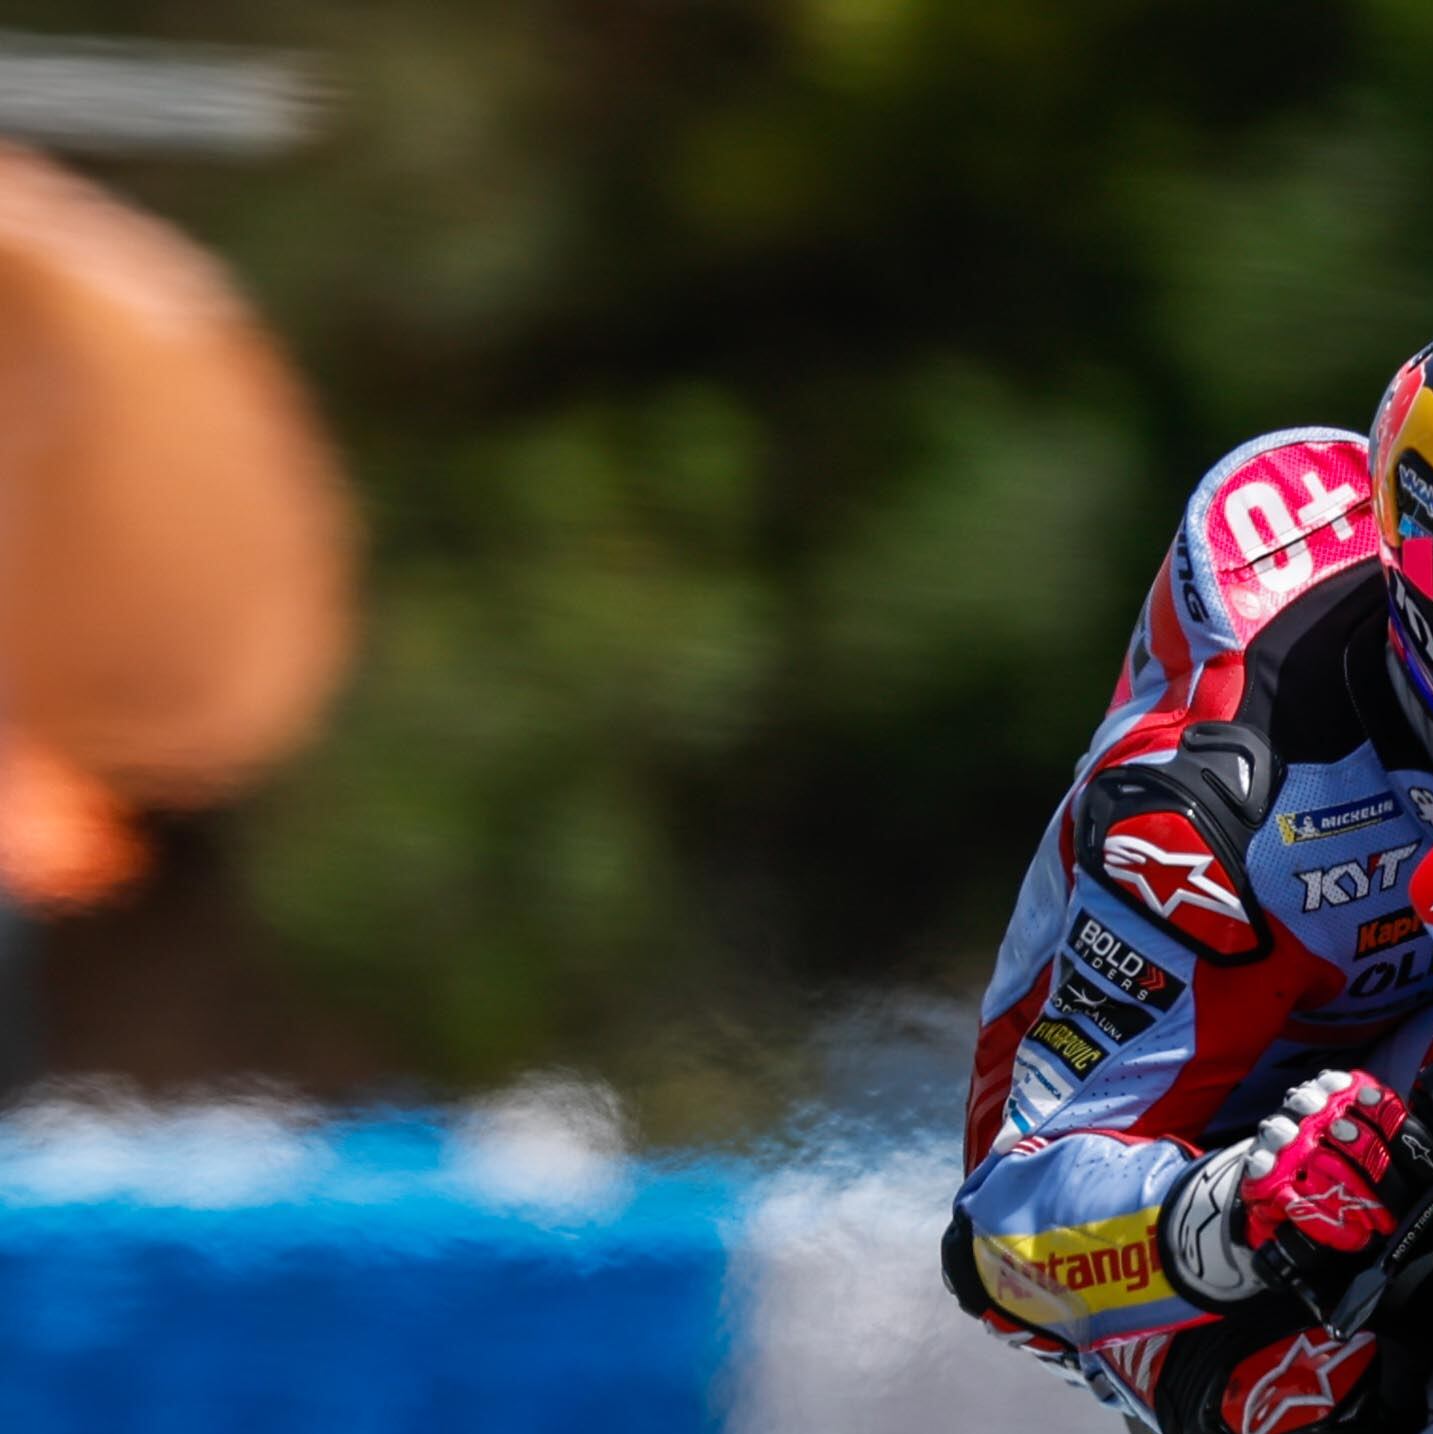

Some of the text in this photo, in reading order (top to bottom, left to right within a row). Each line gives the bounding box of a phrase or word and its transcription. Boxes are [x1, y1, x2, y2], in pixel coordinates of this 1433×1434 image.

[1320, 799, 1394, 830] MICHELIN
[1296, 841, 1421, 913] KYT
[1074, 940, 1149, 1001] RIDERS
[1080, 919, 1144, 978] BOLD
